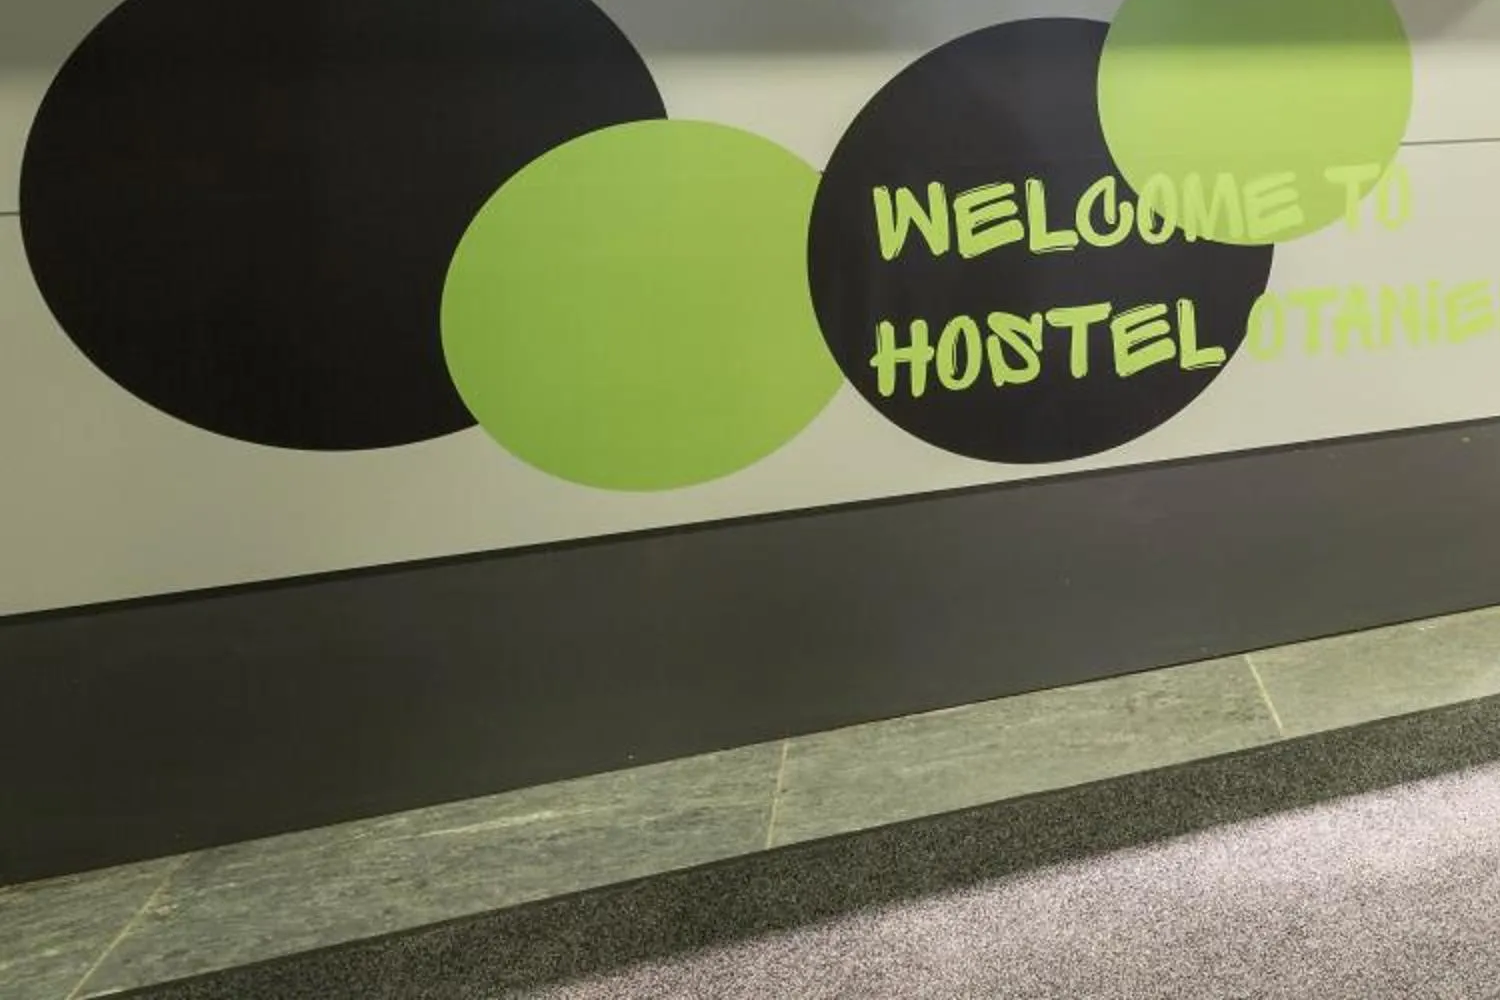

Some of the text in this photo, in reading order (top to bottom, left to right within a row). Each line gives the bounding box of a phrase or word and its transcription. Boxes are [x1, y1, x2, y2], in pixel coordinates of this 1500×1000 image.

[872, 163, 1412, 260] WELCOME TO
[870, 298, 1226, 397] HOSTEL
